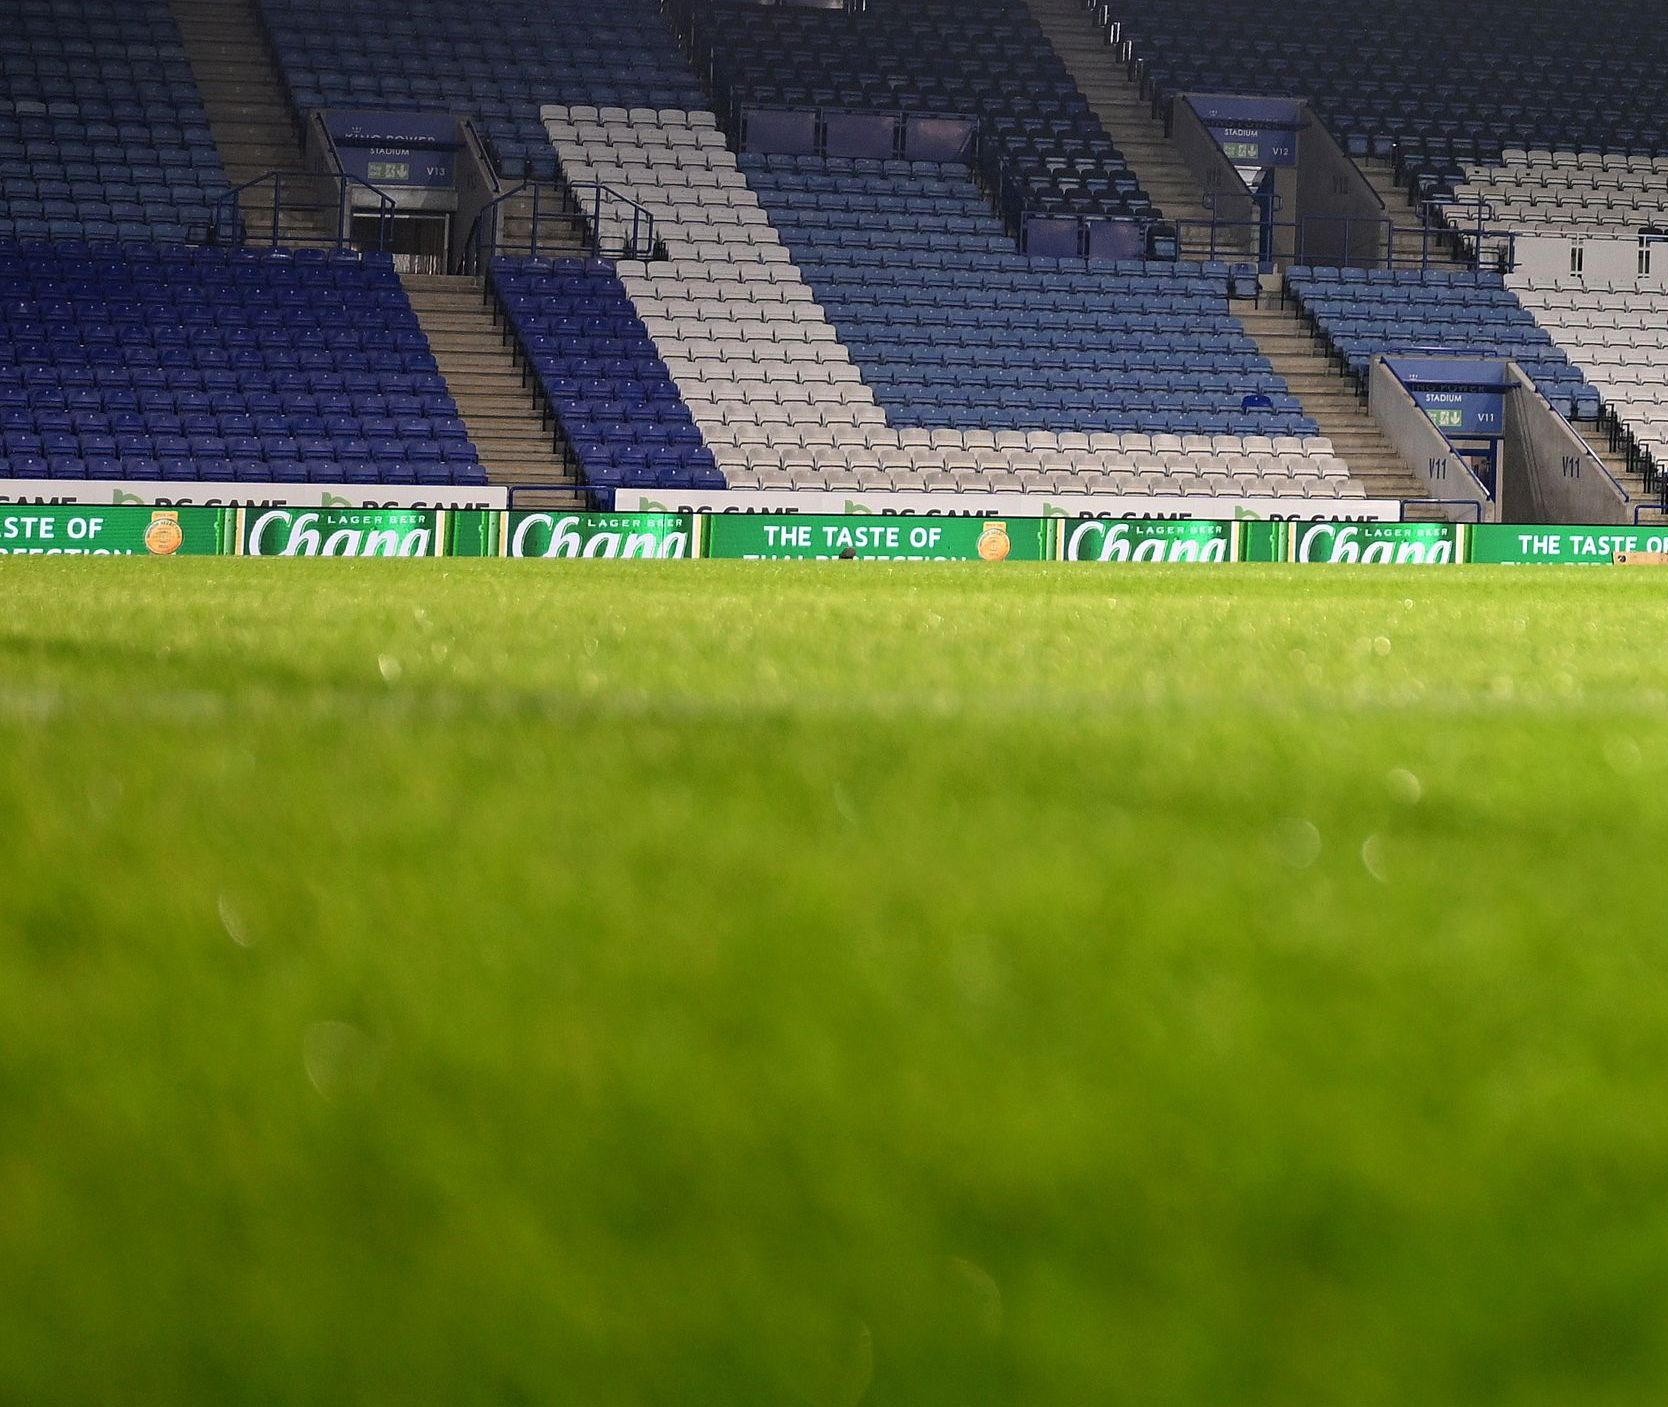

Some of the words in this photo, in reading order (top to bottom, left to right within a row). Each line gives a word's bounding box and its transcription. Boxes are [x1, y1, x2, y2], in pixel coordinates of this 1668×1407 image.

[1224, 128, 1258, 138] STADIUM
[1272, 147, 1289, 156] V12
[426, 167, 446, 177] V13
[1425, 394, 1462, 403] STADIUM
[1477, 413, 1494, 423] V11
[1428, 457, 1447, 480] V11
[1562, 456, 1580, 479] V11
[327, 515, 382, 525] LAGER
[390, 514, 426, 524] BEER
[588, 518, 640, 528] LAGER
[646, 518, 684, 528] BEER
[0, 517, 55, 540] STE
[67, 517, 105, 541] OF
[1136, 527, 1185, 535] LAGER
[1365, 528, 1412, 537] LAGER
[763, 526, 812, 547] THE
[822, 526, 900, 548] TASTE
[909, 527, 942, 549] OF
[1518, 535, 1561, 555] THE
[1570, 536, 1637, 555] TASTE
